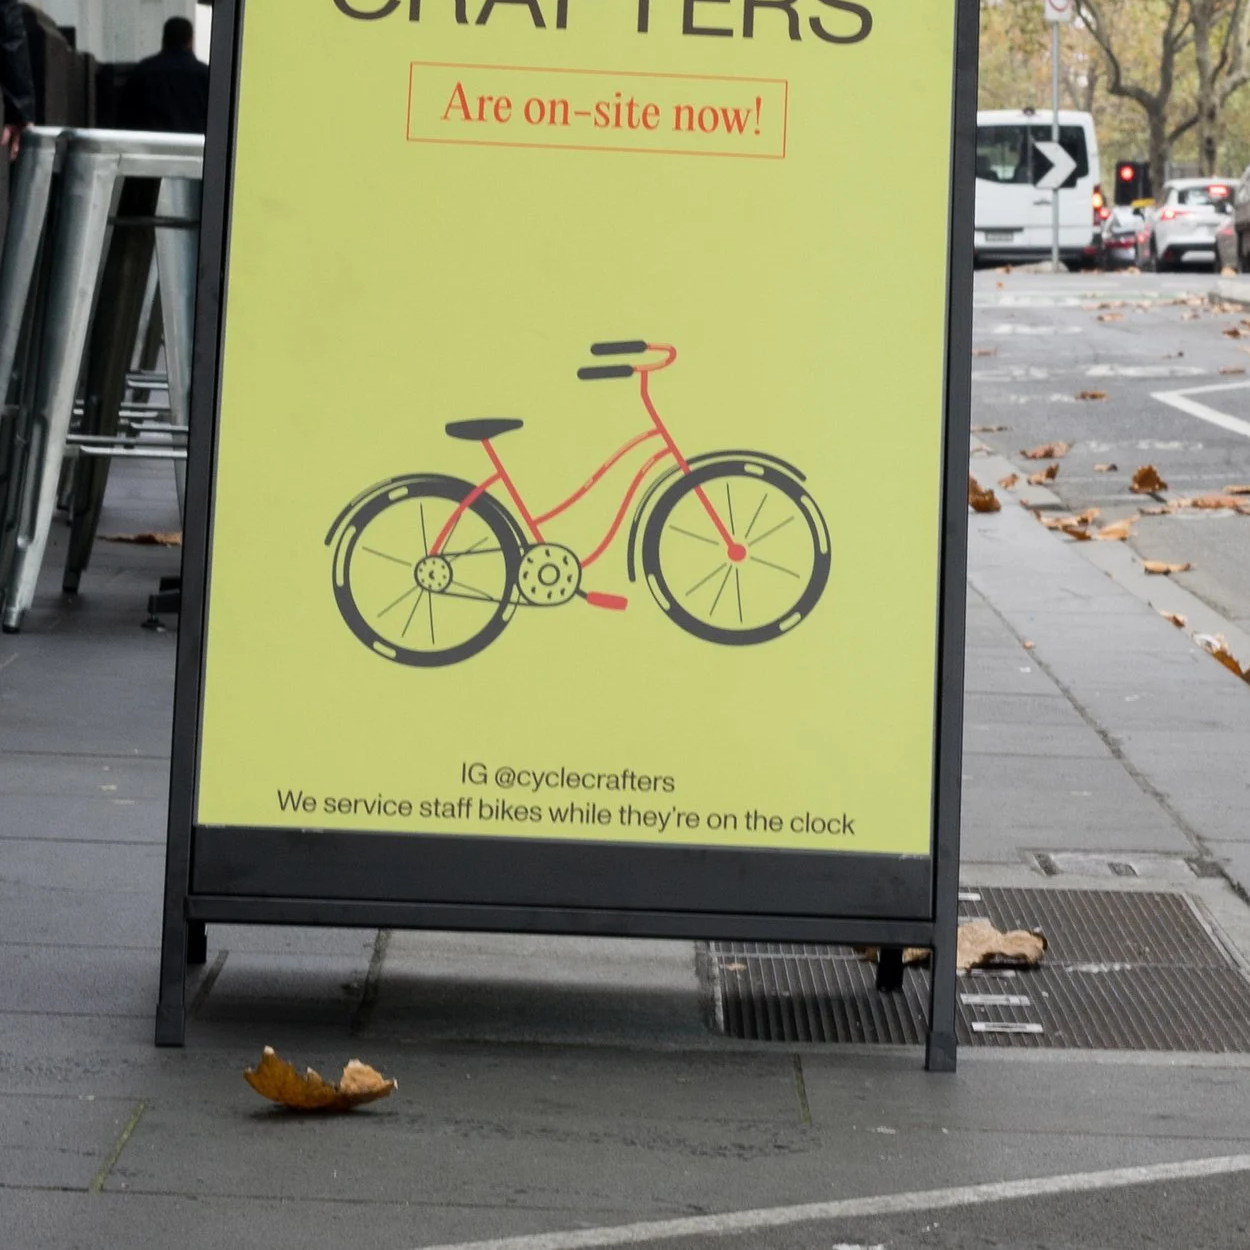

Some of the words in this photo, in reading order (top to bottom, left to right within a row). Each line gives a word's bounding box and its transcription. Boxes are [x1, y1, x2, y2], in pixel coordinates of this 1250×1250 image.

[442, 81, 513, 124] Are
[523, 91, 660, 131] on-site
[674, 96, 762, 136] now!
[461, 761, 488, 785] IG
[494, 766, 676, 793] @cyclecrafters
[277, 789, 317, 813] We
[323, 793, 413, 817] service
[419, 797, 473, 820] staff
[477, 797, 543, 823] bikes
[548, 801, 612, 825] while
[618, 804, 701, 833] they're
[706, 813, 738, 830] on
[744, 810, 784, 832] the
[790, 811, 855, 835] clock
